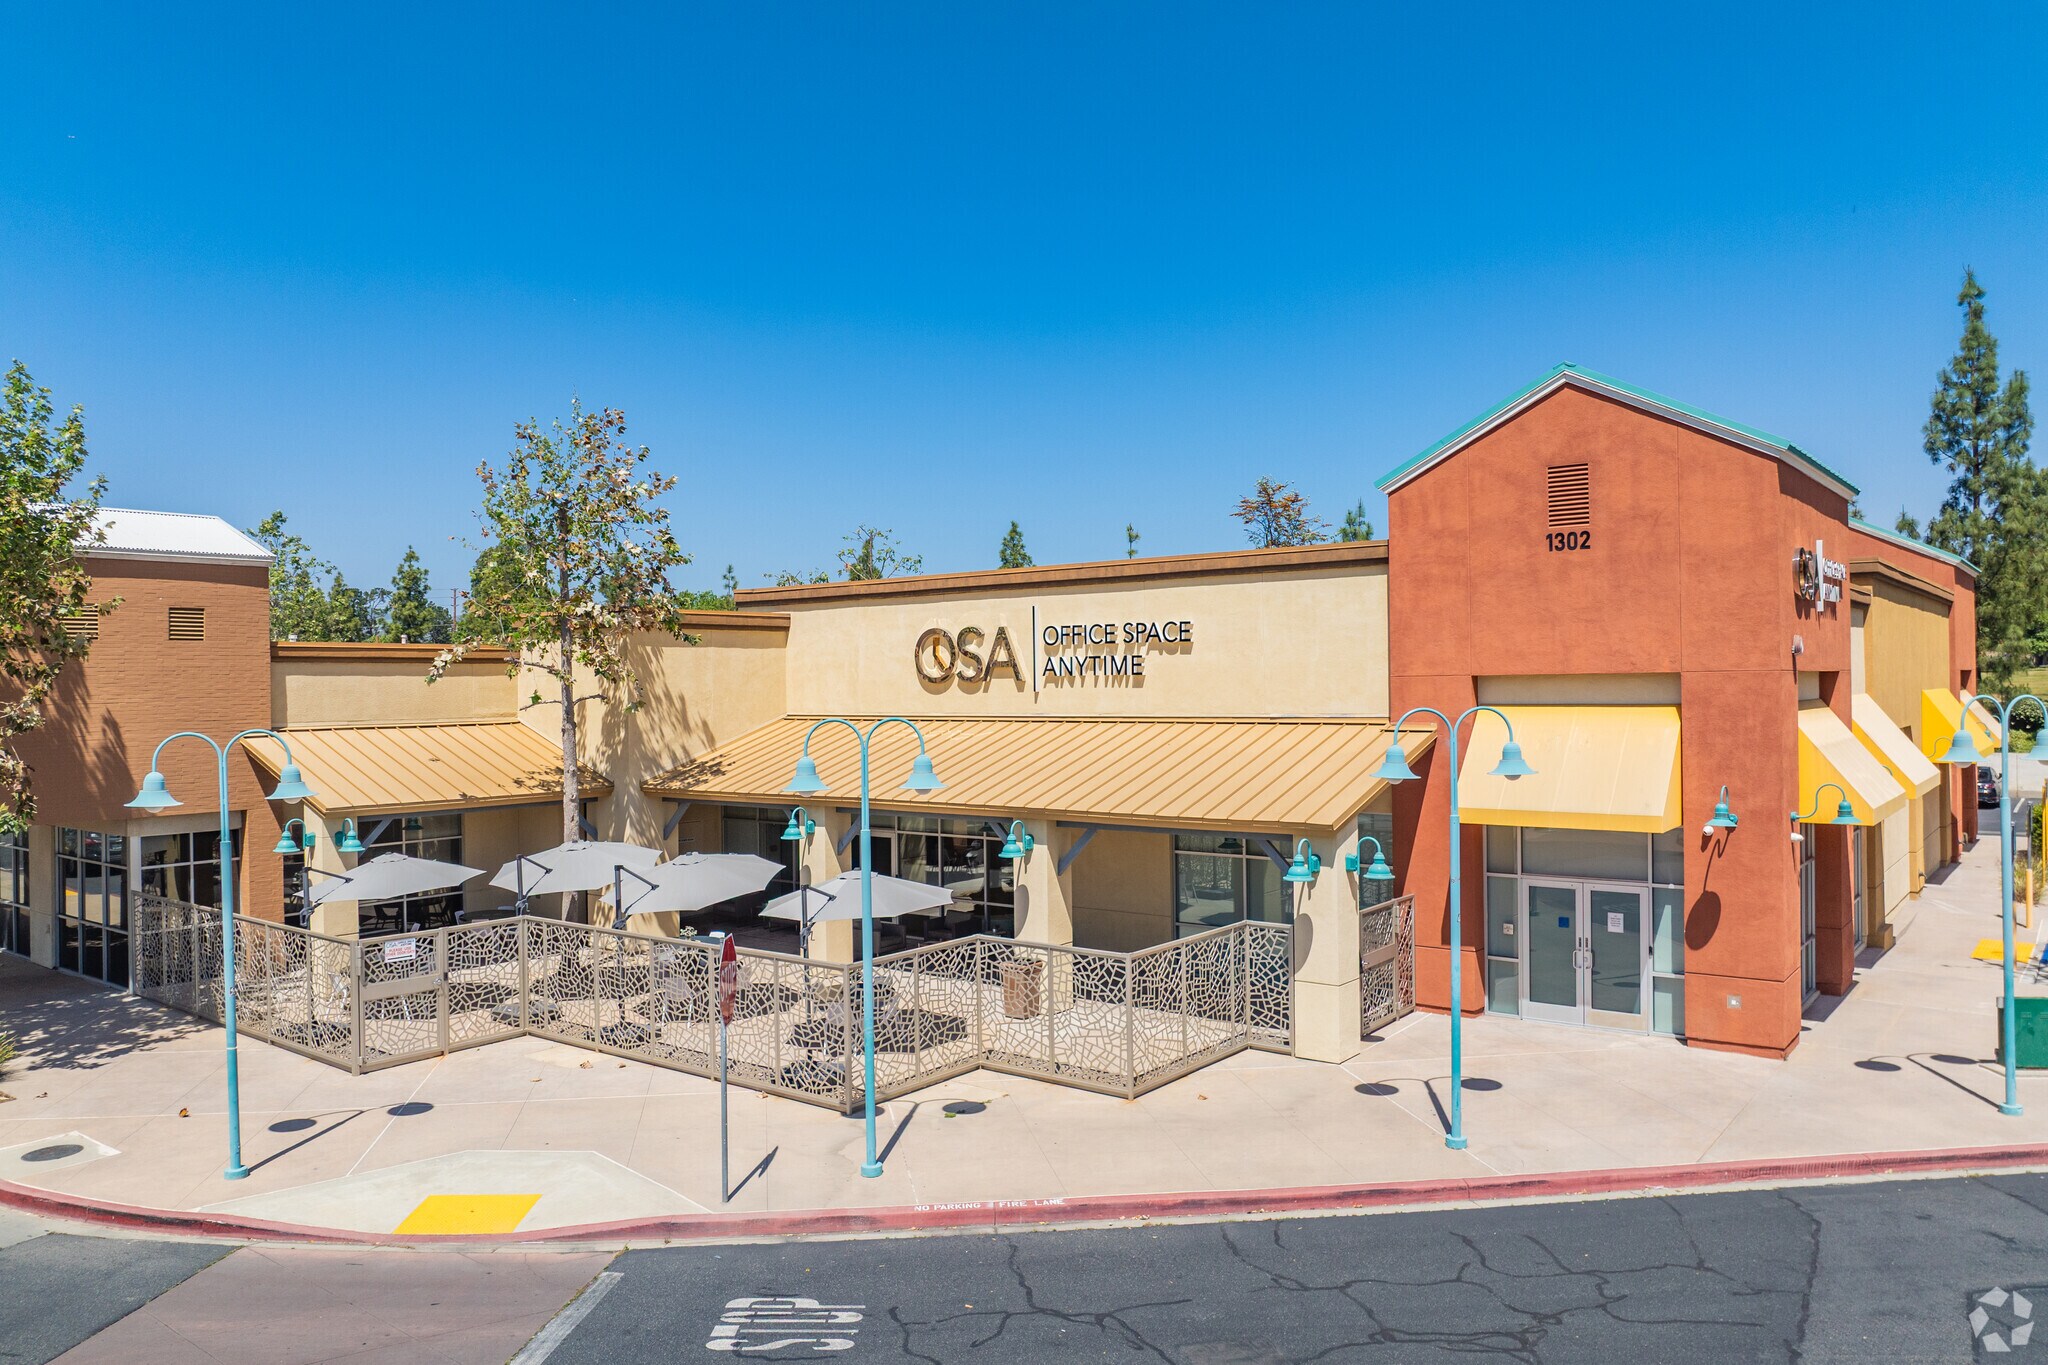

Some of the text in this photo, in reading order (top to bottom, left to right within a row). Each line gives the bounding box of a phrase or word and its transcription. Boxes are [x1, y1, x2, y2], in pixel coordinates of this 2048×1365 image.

[1545, 531, 1591, 552] 1302
[1043, 621, 1192, 646] OFFICE SPACE
[914, 626, 1026, 684] OSA
[1043, 655, 1144, 677] ANYTIME
[721, 961, 736, 1002] STOP
[934, 1202, 981, 1210] PARKING
[705, 1297, 866, 1351] STOP
